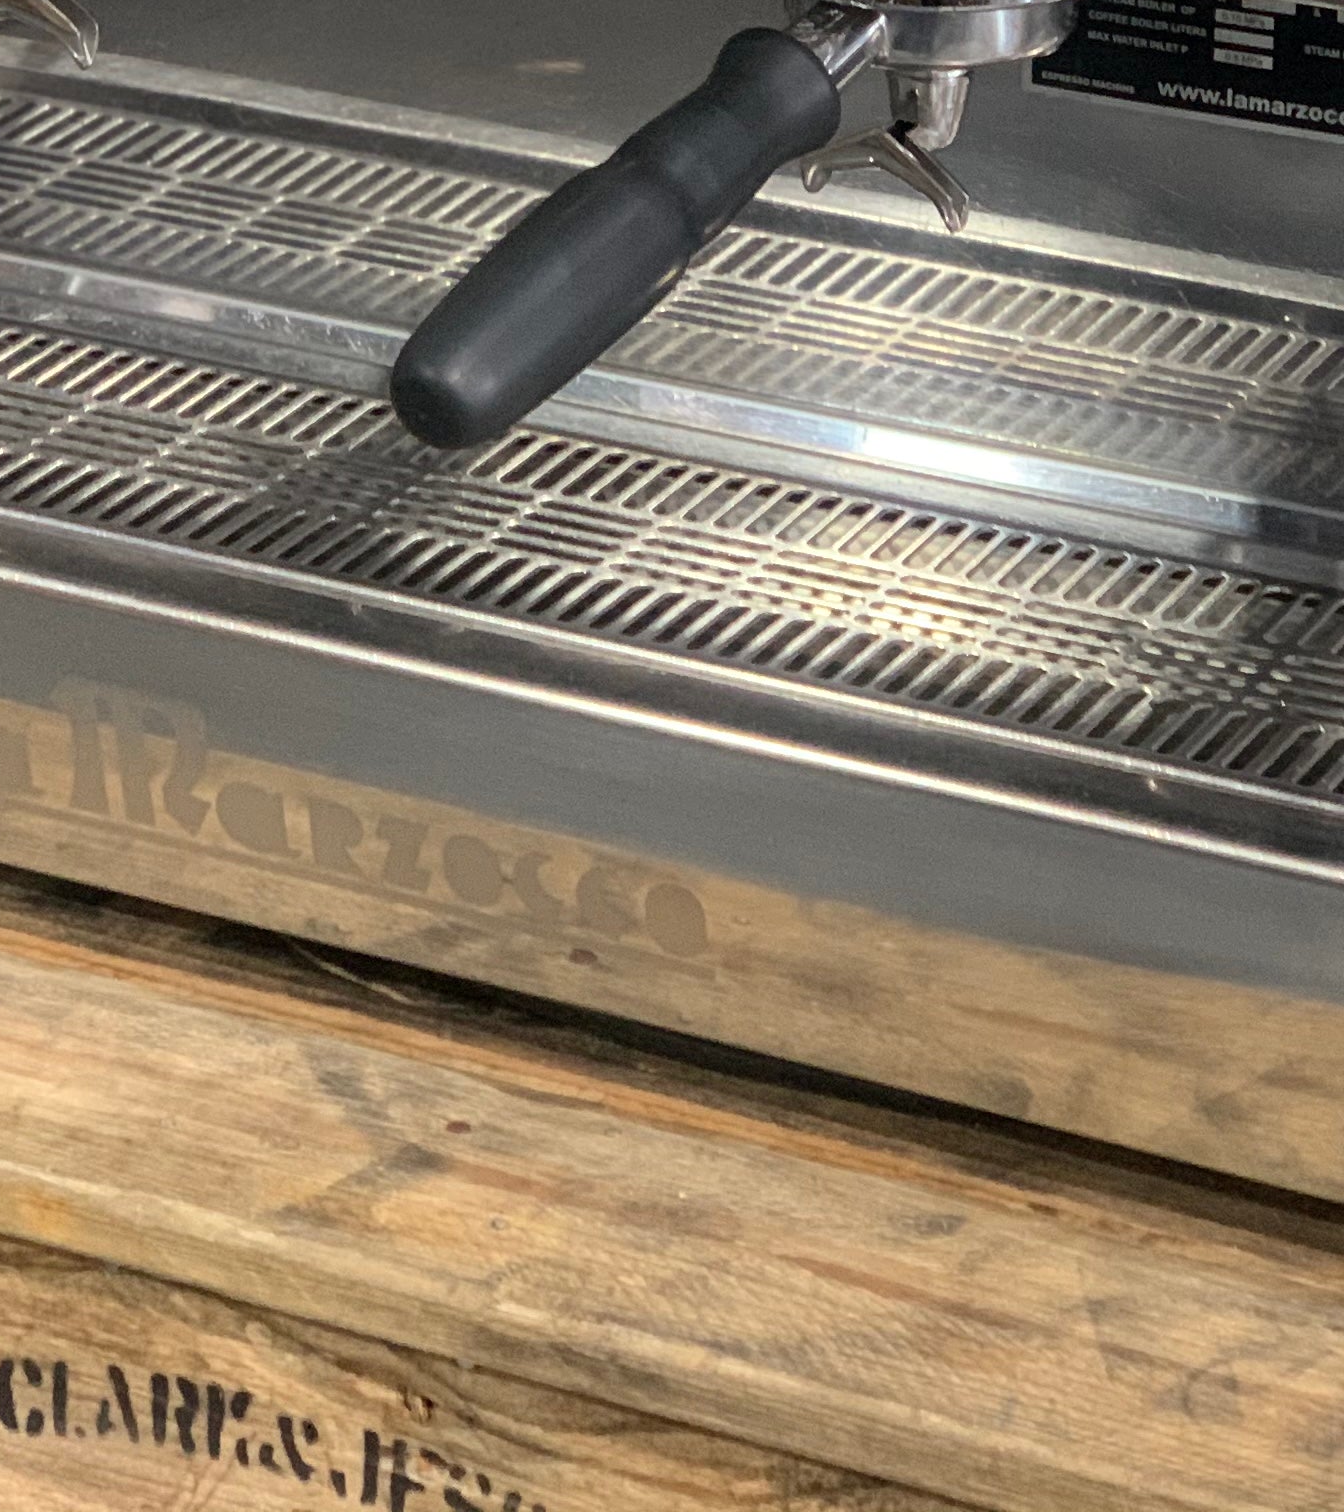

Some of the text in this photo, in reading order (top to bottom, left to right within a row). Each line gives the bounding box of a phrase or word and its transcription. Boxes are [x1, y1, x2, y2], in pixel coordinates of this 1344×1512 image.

[1088, 9, 1207, 37] COFFEE BOILER LITERS
[1087, 30, 1110, 42] MAX
[1112, 34, 1148, 49] WATER
[1303, 44, 1340, 59] STEAM
[1092, 77, 1136, 95] MACHINE
